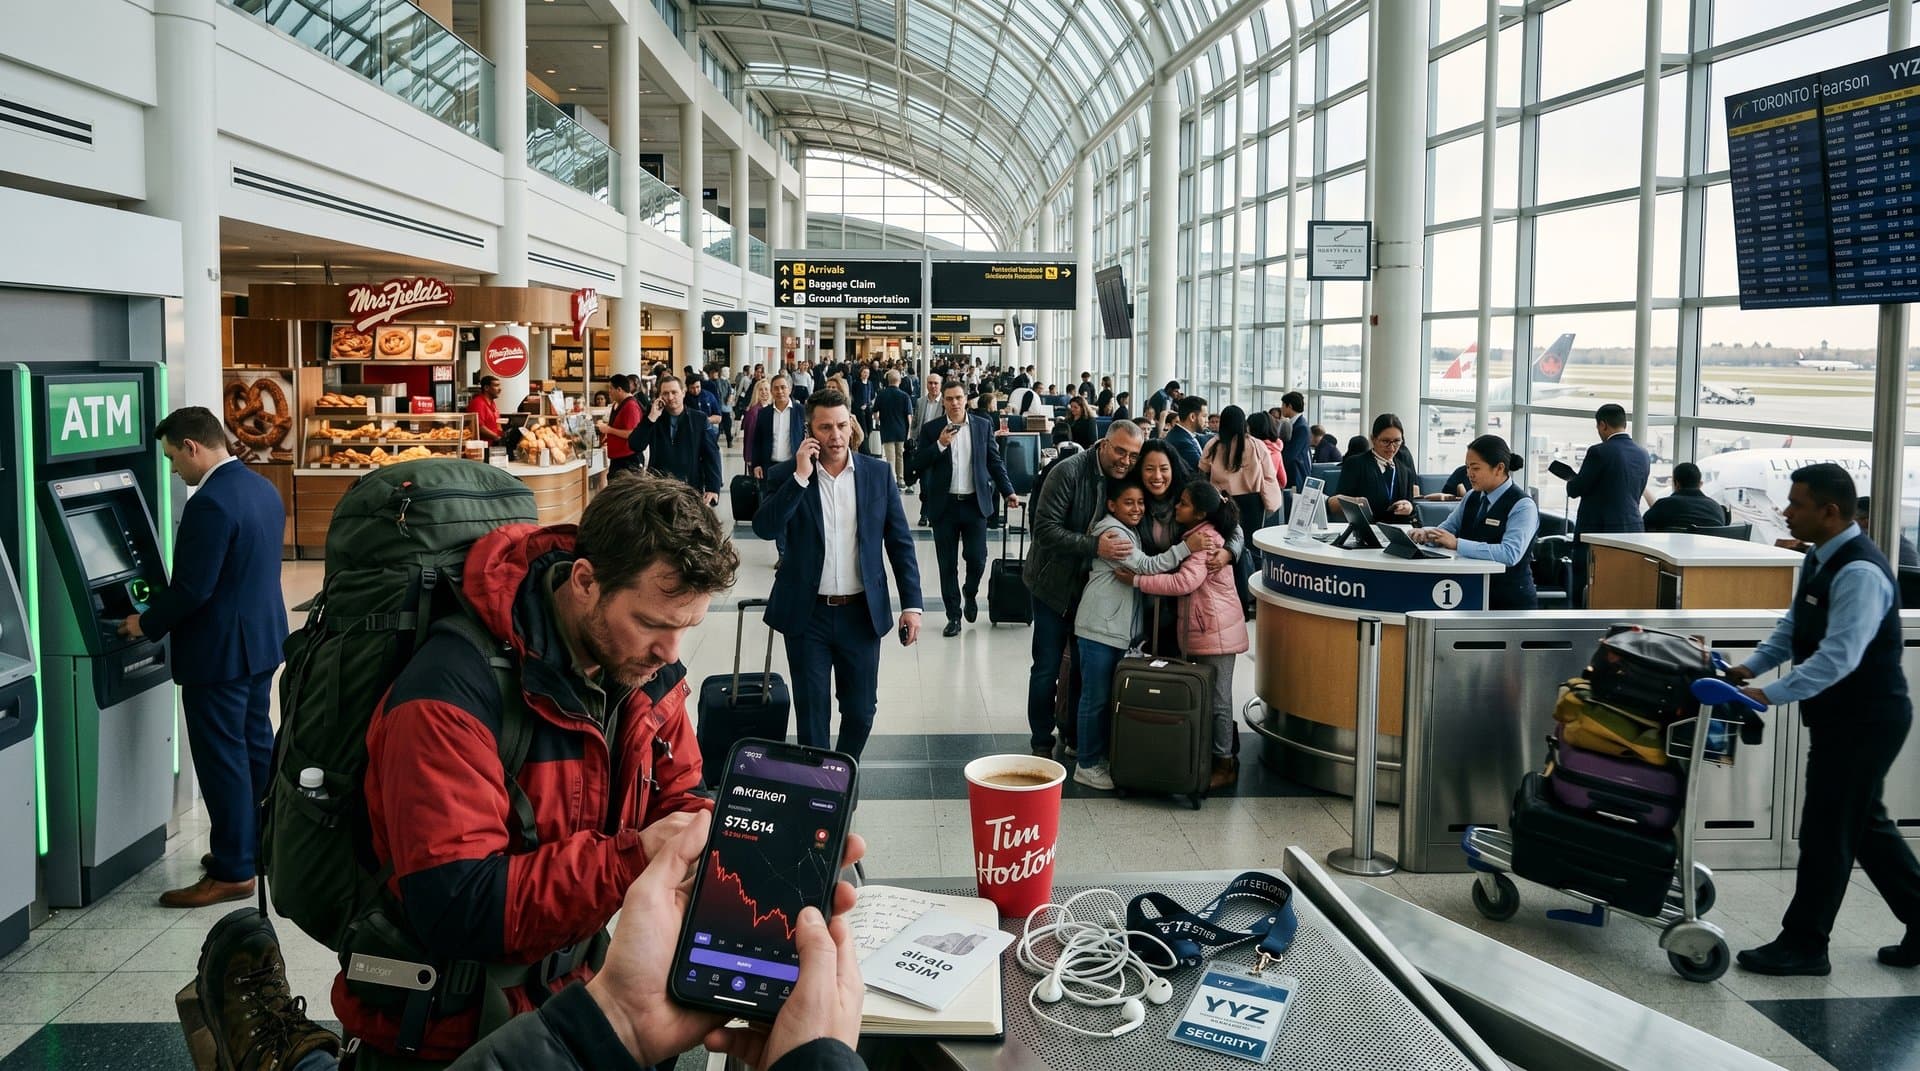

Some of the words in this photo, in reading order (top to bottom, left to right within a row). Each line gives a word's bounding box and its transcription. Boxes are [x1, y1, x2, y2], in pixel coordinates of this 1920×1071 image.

[1752, 87, 1810, 113] TORONTO
[1813, 74, 1870, 98] Pearson
[1889, 57, 1920, 80] YYZ
[808, 264, 845, 274] Arrivals
[808, 280, 848, 291] Baggage
[850, 279, 876, 289] Claim
[808, 294, 842, 303] Ground
[844, 294, 910, 305] Transportation
[61, 394, 132, 440] ATM
[1270, 560, 1366, 599] Information
[724, 815, 774, 834] $75,614
[985, 815, 1040, 851] Tim
[895, 961, 940, 980] eSIM
[901, 950, 953, 972] airalo
[1205, 995, 1269, 1025] YYZ
[1184, 1026, 1259, 1051] SECURITY
